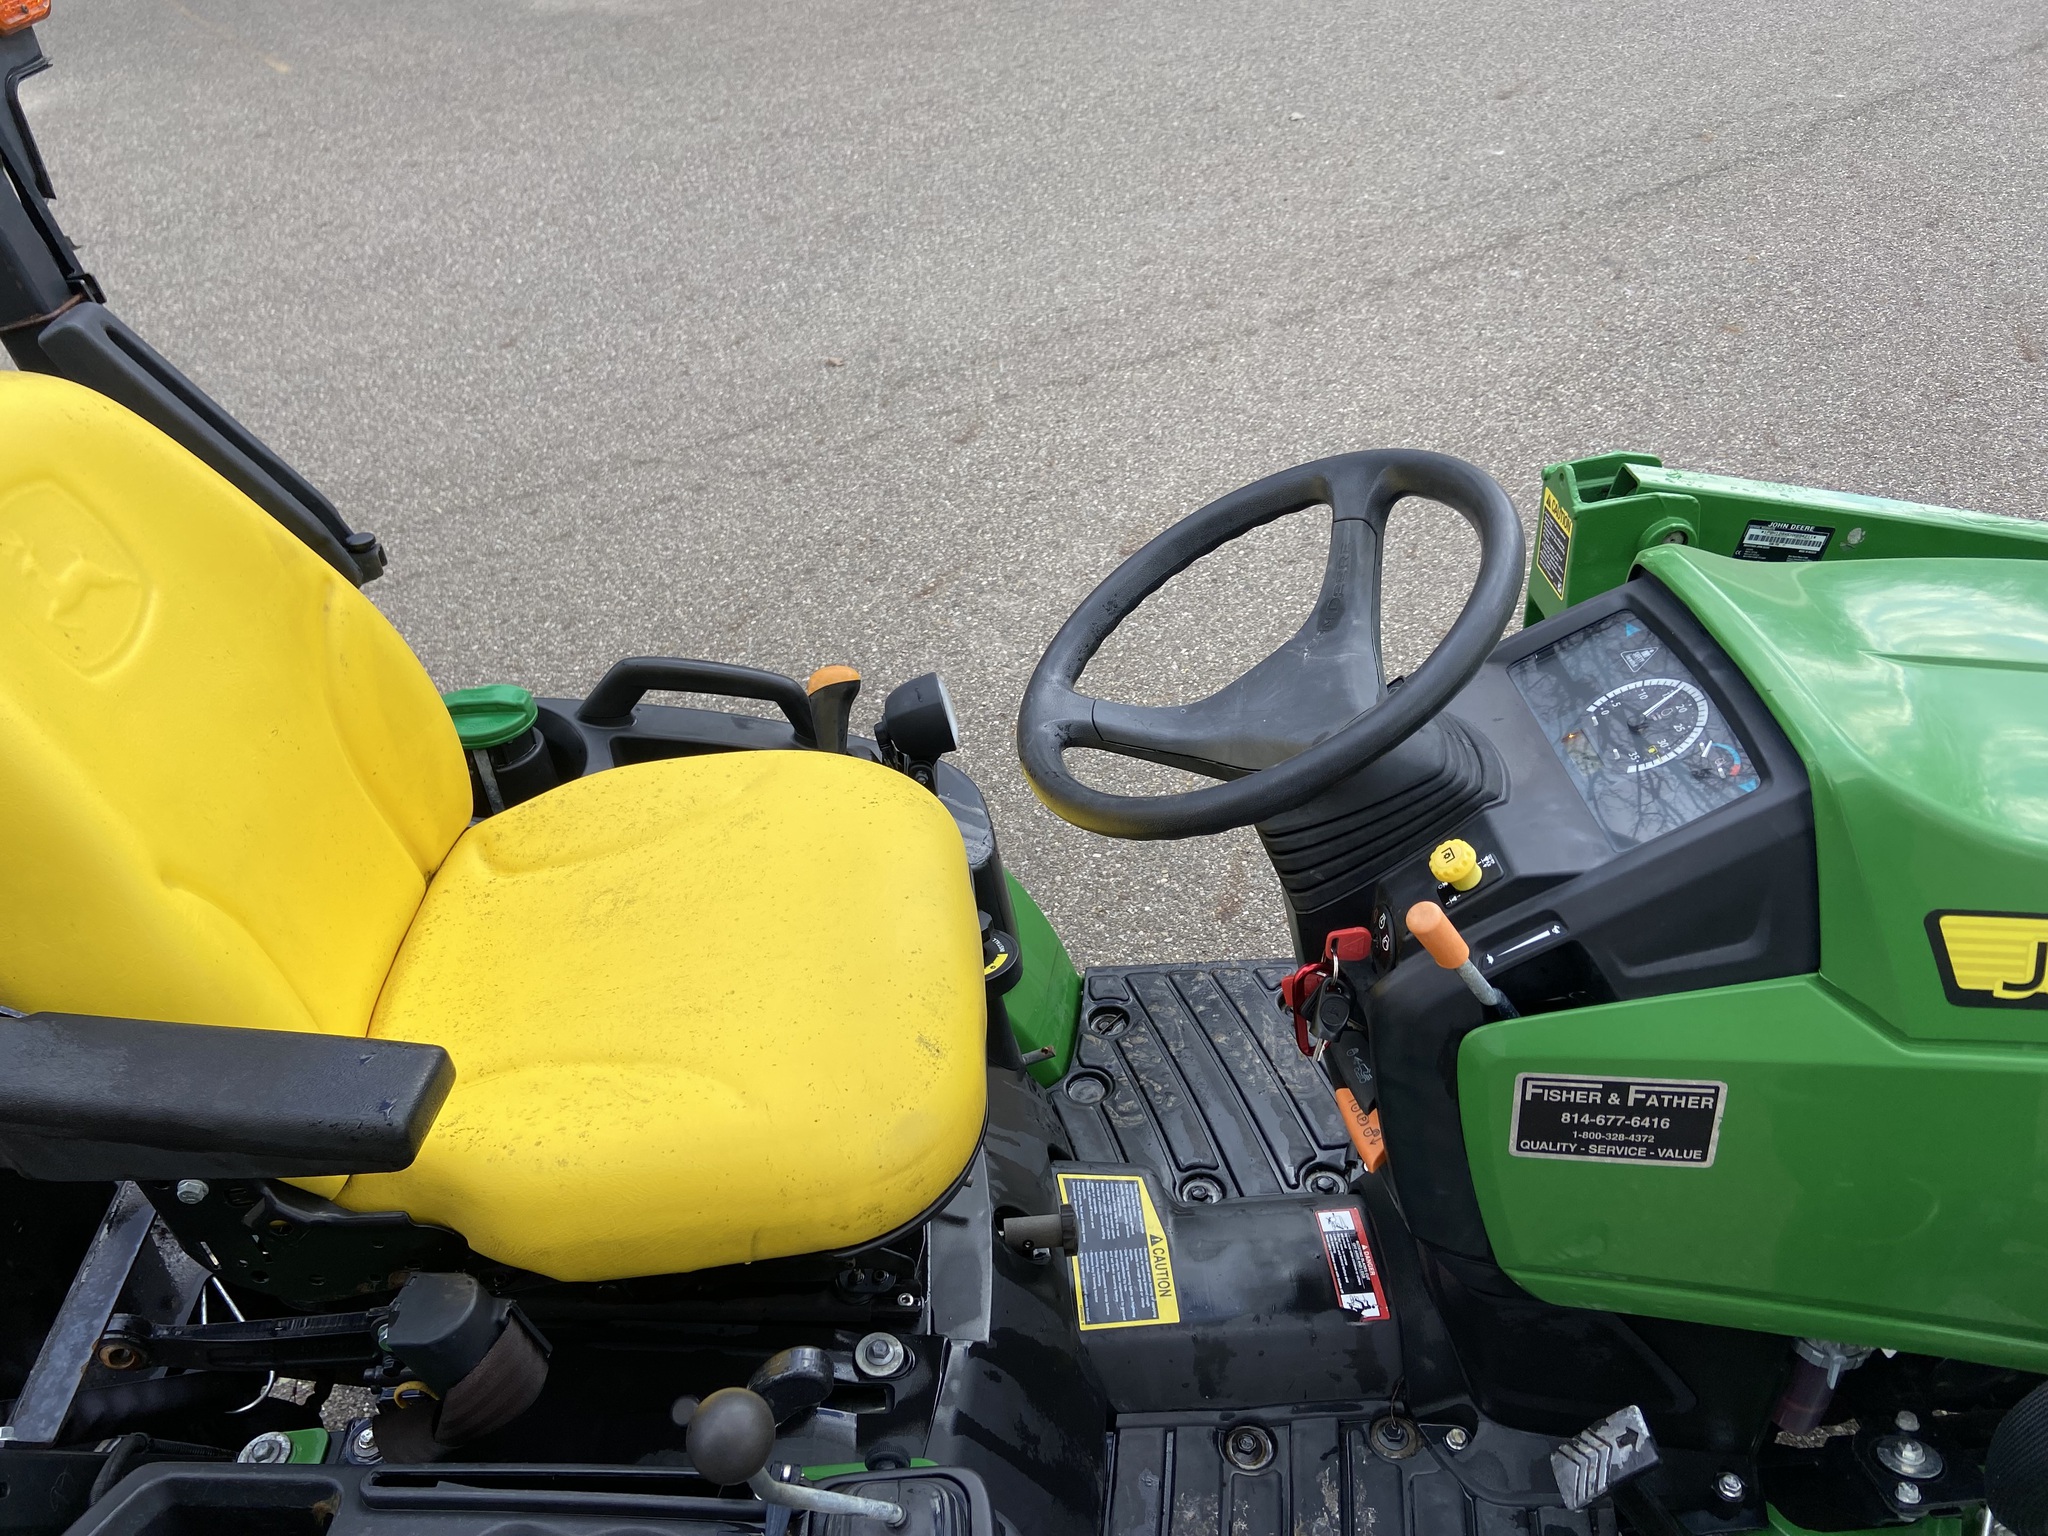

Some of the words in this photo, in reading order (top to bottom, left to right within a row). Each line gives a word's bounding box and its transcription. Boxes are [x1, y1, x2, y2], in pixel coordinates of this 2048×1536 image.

[1551, 499, 1571, 534] CAUTION
[1768, 521, 1789, 529] JOHN
[1638, 691, 1649, 700] 10
[1675, 704, 1688, 713] 20
[1673, 723, 1686, 732] 25
[1657, 738, 1669, 748] 30
[1628, 751, 1640, 760] 35
[1525, 1080, 1603, 1105] FISHER
[1607, 1093, 1620, 1105] &
[1628, 1085, 1715, 1110] FATHER
[1560, 1112, 1670, 1130] 814-677-6416
[1572, 1130, 1655, 1143] 1-800-328-4372
[1520, 1139, 1578, 1153] QUALITY
[1588, 1144, 1647, 1157] SERVICE
[1658, 1148, 1703, 1160] VALUE
[1363, 1251, 1376, 1276] DANGER
[1152, 1248, 1172, 1298] CAUTION
